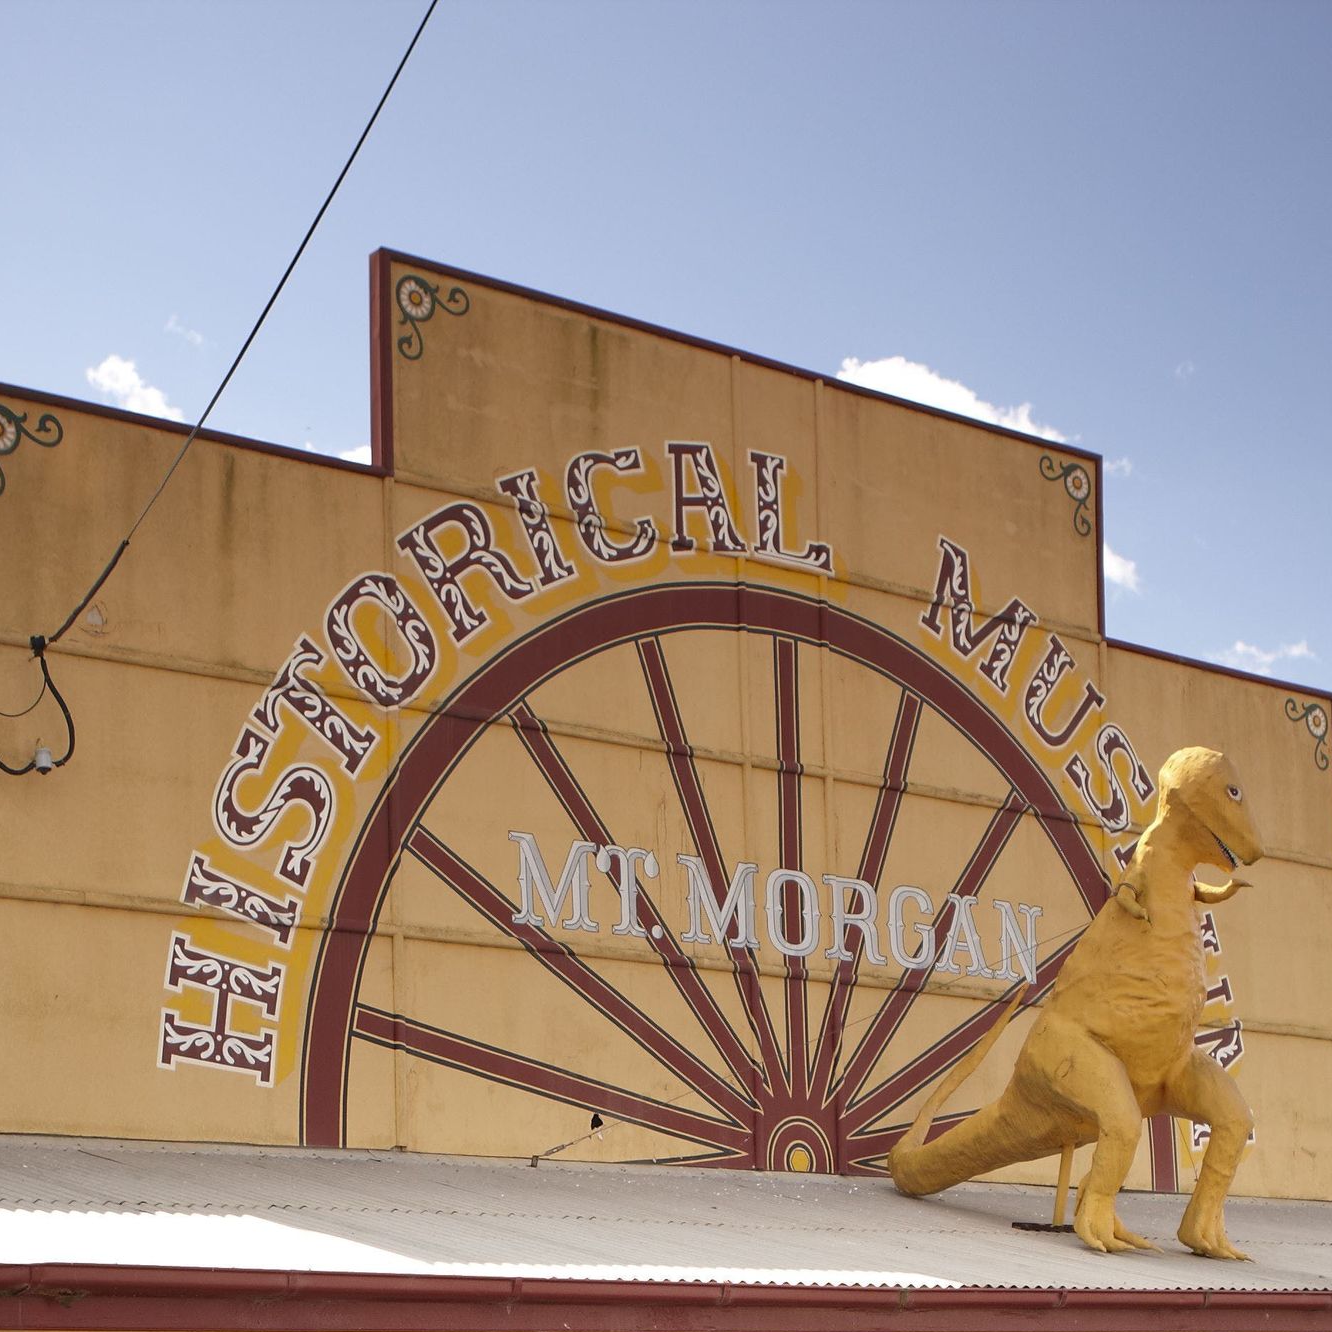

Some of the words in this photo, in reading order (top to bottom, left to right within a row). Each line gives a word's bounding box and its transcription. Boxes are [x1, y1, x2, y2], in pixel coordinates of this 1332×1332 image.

[156, 440, 835, 1088] HISTORICAL
[507, 830, 665, 940] MT.
[676, 853, 1044, 985] MORGAN
